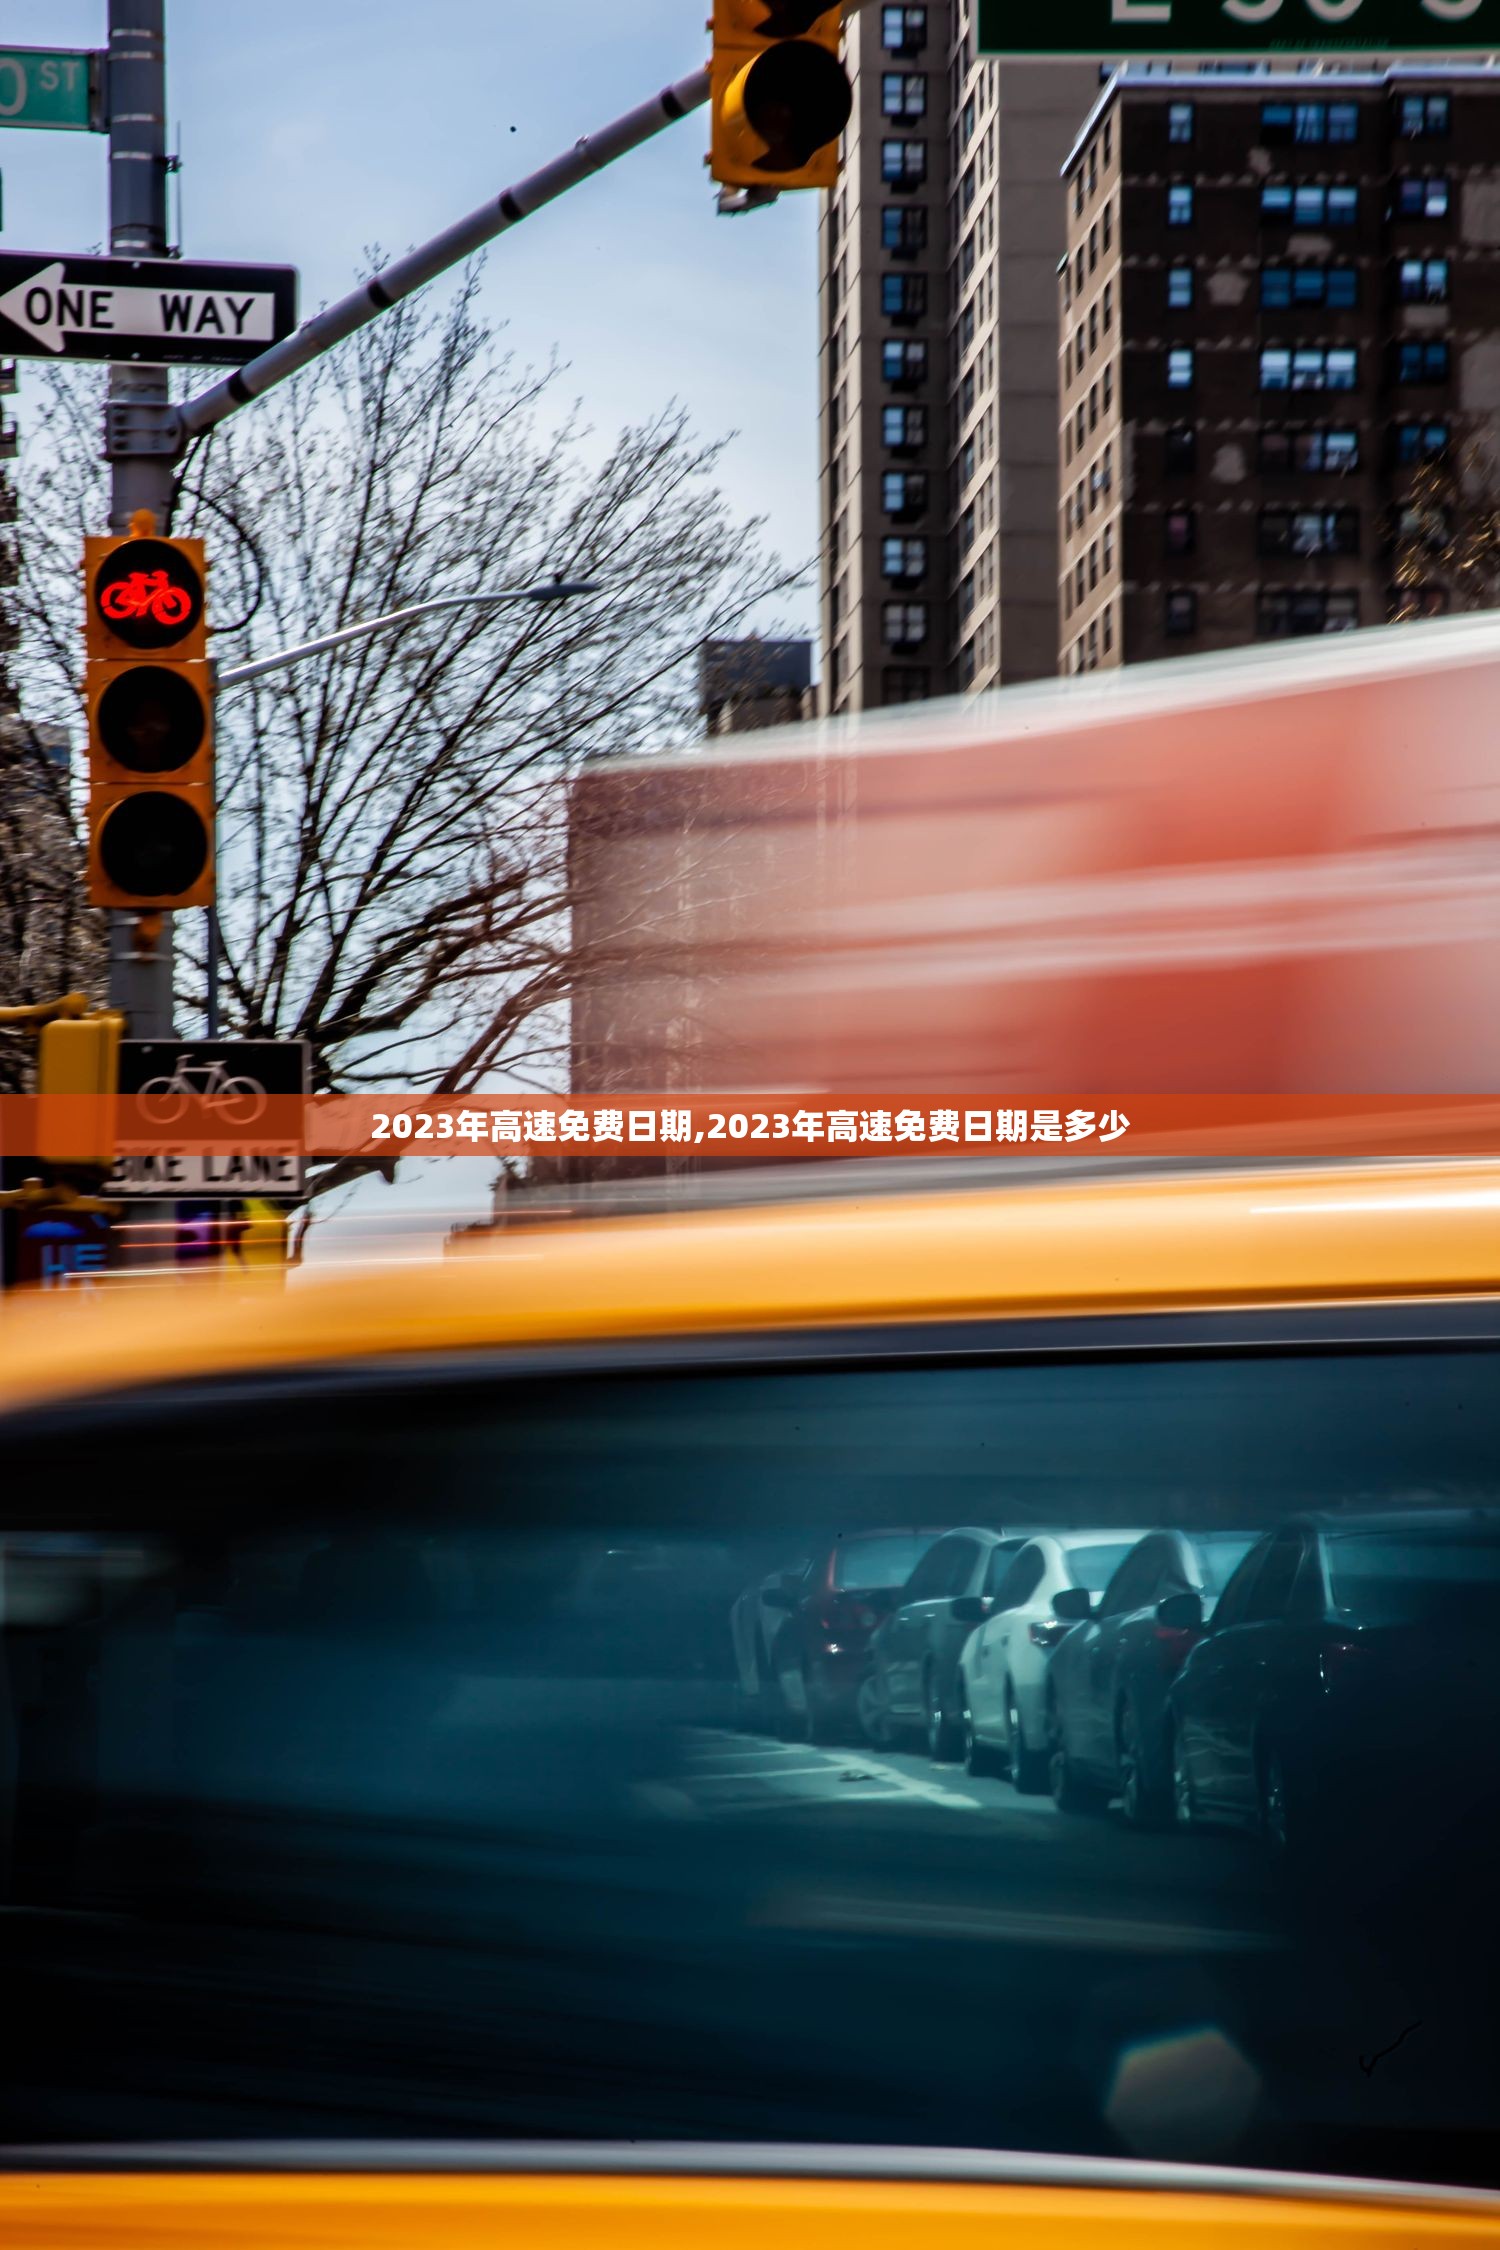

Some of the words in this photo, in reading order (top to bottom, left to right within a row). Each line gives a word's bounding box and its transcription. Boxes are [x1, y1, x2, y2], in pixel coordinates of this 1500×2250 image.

[40, 60, 81, 92] ST
[24, 287, 114, 329] ONE
[160, 294, 256, 335] WAY
[111, 1147, 188, 1182] BIKE
[202, 1147, 298, 1182] LANE
